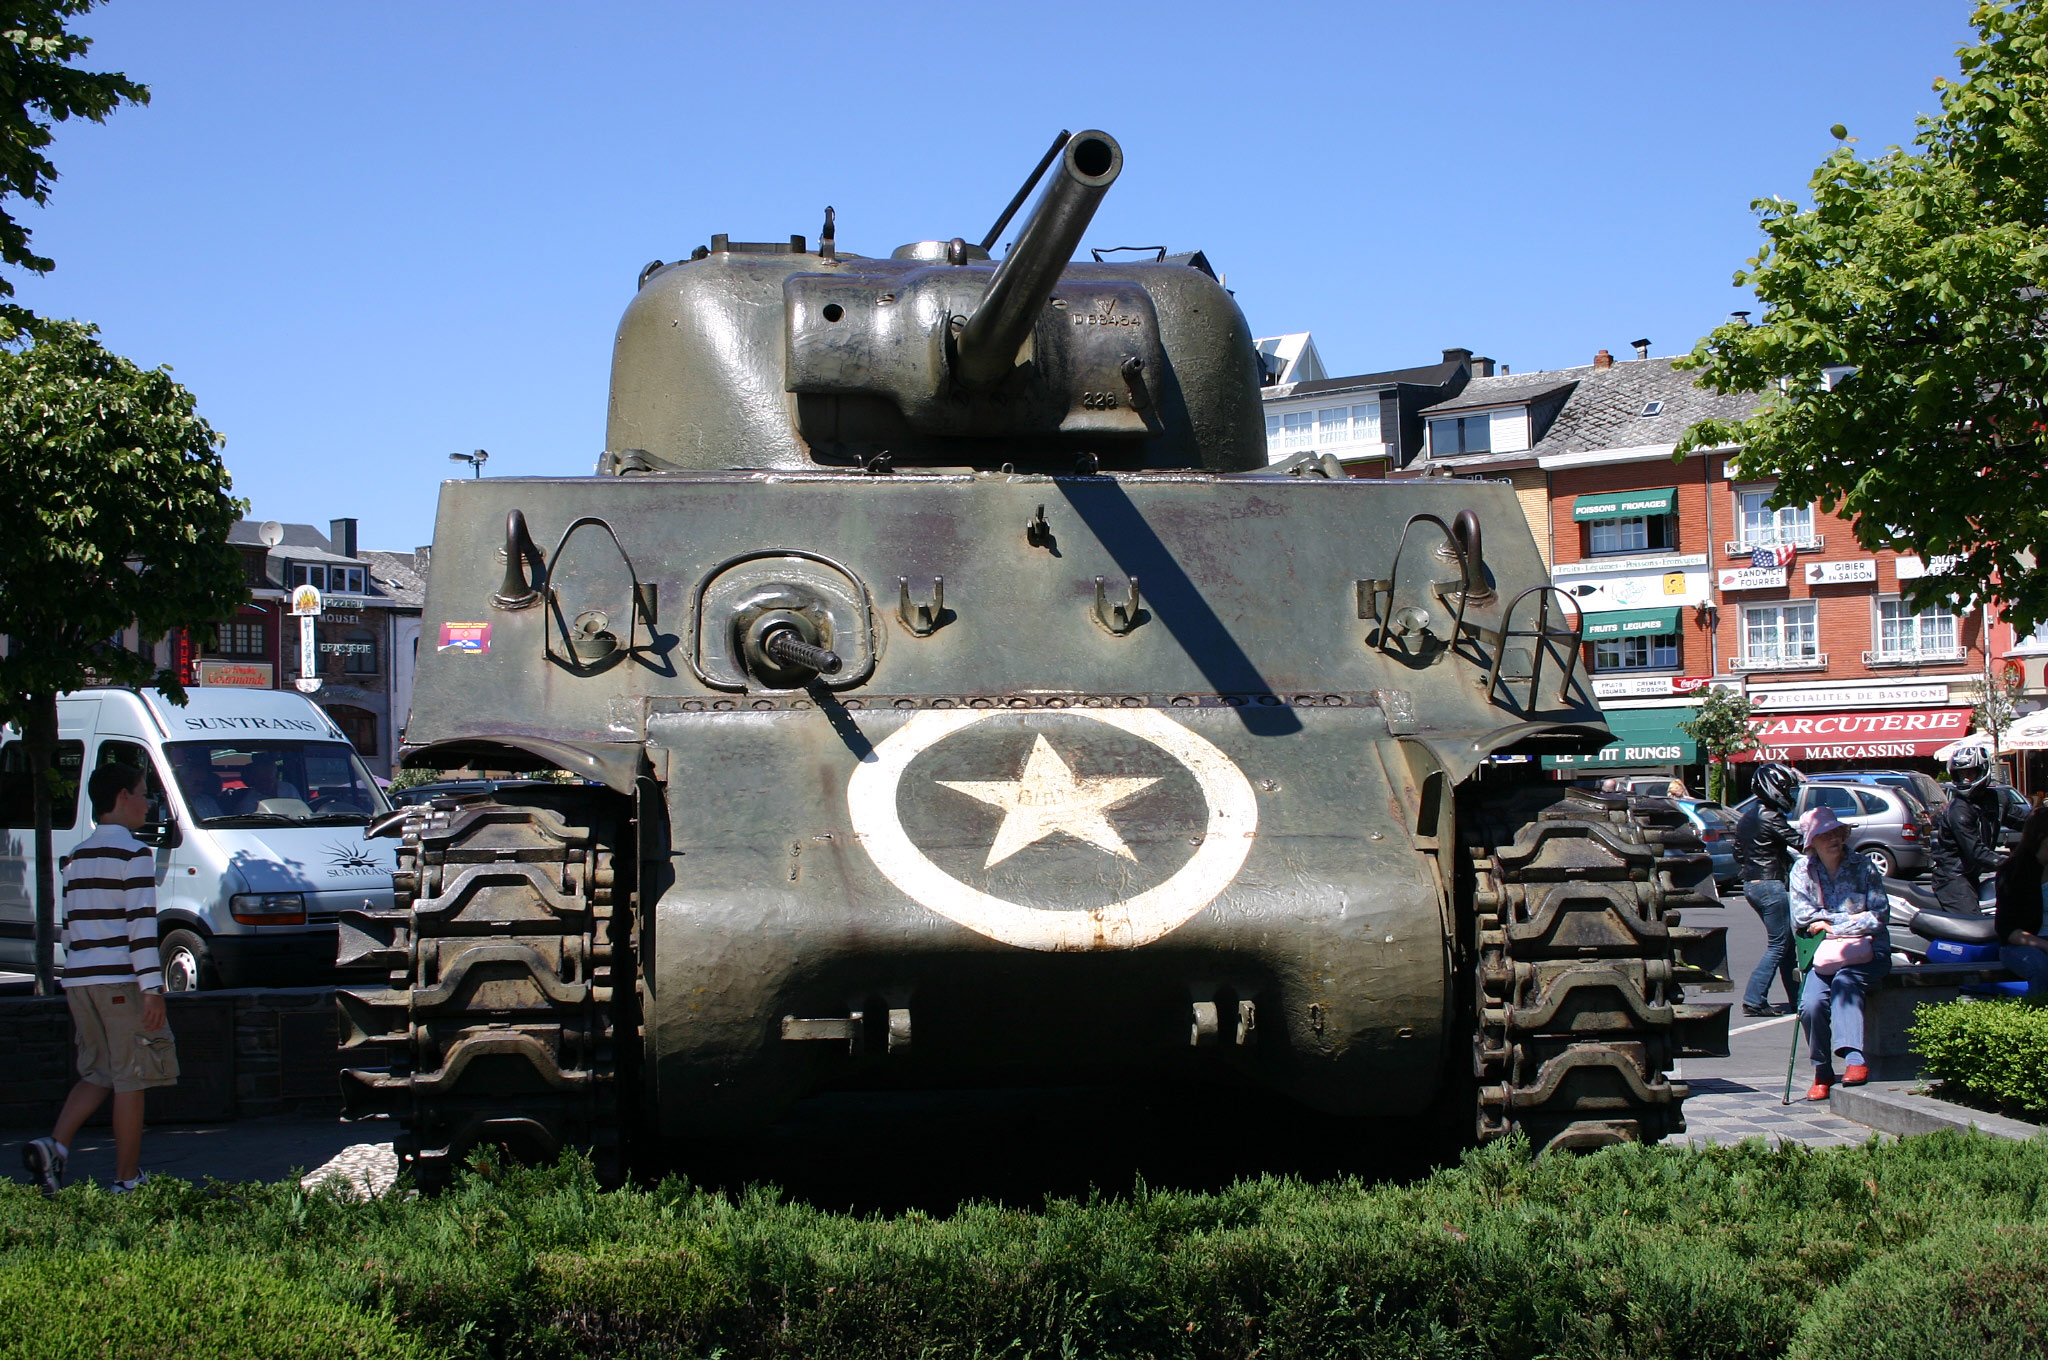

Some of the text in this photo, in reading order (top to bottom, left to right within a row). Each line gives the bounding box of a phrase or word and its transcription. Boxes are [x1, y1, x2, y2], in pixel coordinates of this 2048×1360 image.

[1575, 499, 1667, 515] POISSONS FROMAGES
[1834, 562, 1865, 571] GIBIER
[1737, 568, 1783, 578] SANDWICH
[1838, 571, 1872, 580] SAISON
[1740, 577, 1781, 587] FOURRES
[318, 613, 360, 624] MOUSEL
[1589, 620, 1662, 634] FRUITS LEGUMES
[320, 643, 371, 654] BRASSERIE
[1857, 691, 1873, 701] DE
[1879, 689, 1946, 700] BASTOGNE
[184, 717, 317, 732] SUNTRANS
[1738, 712, 1962, 736] HARCUTERIE
[1625, 746, 1681, 760] RUNGIS
[1753, 743, 1916, 761] AUX MARCASSINS
[326, 867, 394, 878] SUNTRANS
